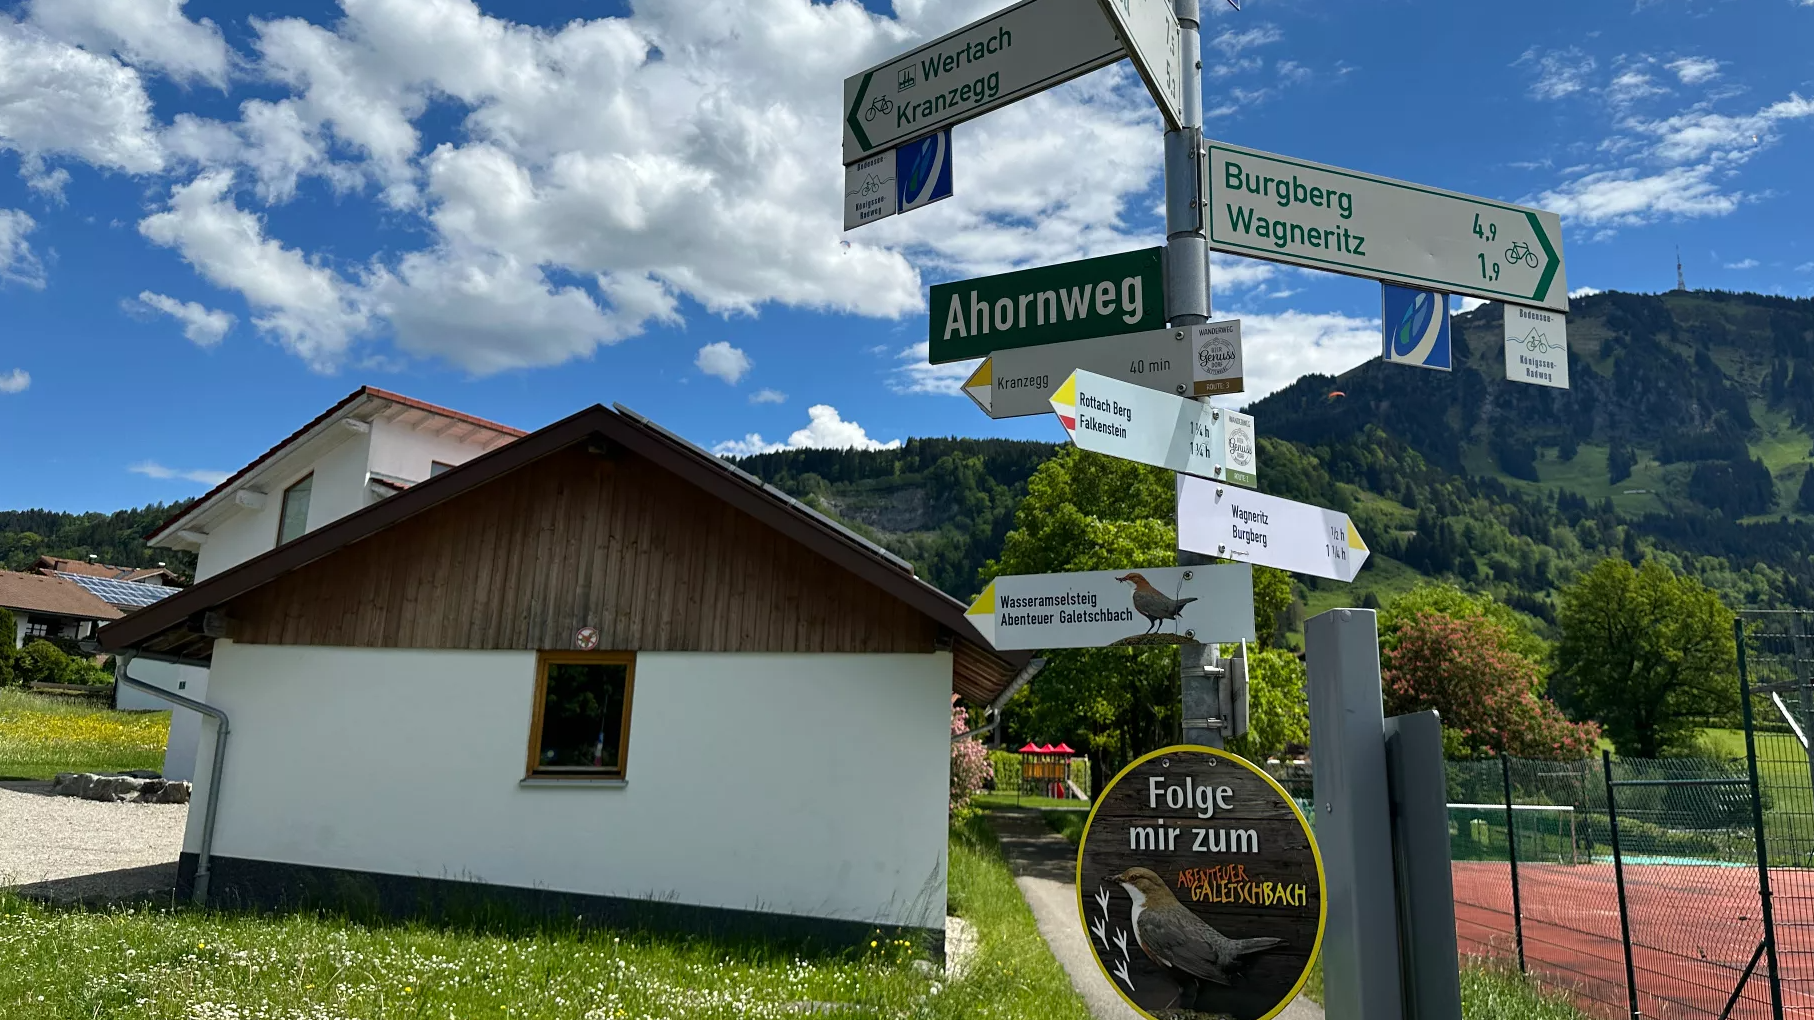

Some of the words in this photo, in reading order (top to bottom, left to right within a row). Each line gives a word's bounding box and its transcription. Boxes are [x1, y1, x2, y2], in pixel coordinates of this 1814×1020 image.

[922, 27, 1012, 82] Wertach
[896, 70, 1000, 128] Kranzegg
[1225, 161, 1353, 220] Burgberg
[856, 196, 886, 211] Königssee-
[860, 207, 882, 220] Radweg
[1226, 203, 1366, 256] Wagneritz
[1472, 213, 1497, 242] 4,9
[1477, 252, 1500, 282] 1,9
[943, 274, 1144, 341] Ahornweg
[1520, 308, 1554, 322] Bodensee-
[1199, 326, 1233, 336] WANDERWEG
[1198, 350, 1236, 367] Genuss
[1520, 354, 1557, 369] Königssee-
[997, 373, 1049, 390] Kranzegg
[1130, 361, 1144, 374] 40
[1149, 358, 1170, 373] min
[1526, 368, 1552, 382] Radweg
[1079, 392, 1110, 414] Rottach
[1113, 400, 1132, 422] Berg
[1079, 415, 1127, 439] Falkenstein
[1190, 421, 1193, 434] 1
[1205, 425, 1209, 438] h
[1190, 442, 1193, 455] 1
[1206, 445, 1210, 458] h
[1231, 504, 1269, 525] Wagneritz
[1340, 528, 1345, 541] h
[1232, 525, 1267, 548] Burgberg
[1326, 544, 1330, 557] 1
[1341, 547, 1346, 560] h
[1000, 591, 1098, 610] Wasseramselsteig
[1000, 610, 1055, 627] Abenteuer
[1059, 607, 1133, 624] Galetschbach
[1149, 776, 1234, 819] Folge
[1130, 819, 1180, 851] mir
[1192, 827, 1259, 853] zum
[1177, 863, 1249, 888] ABENTEUER
[1191, 881, 1307, 906] GALETSCHBACH
